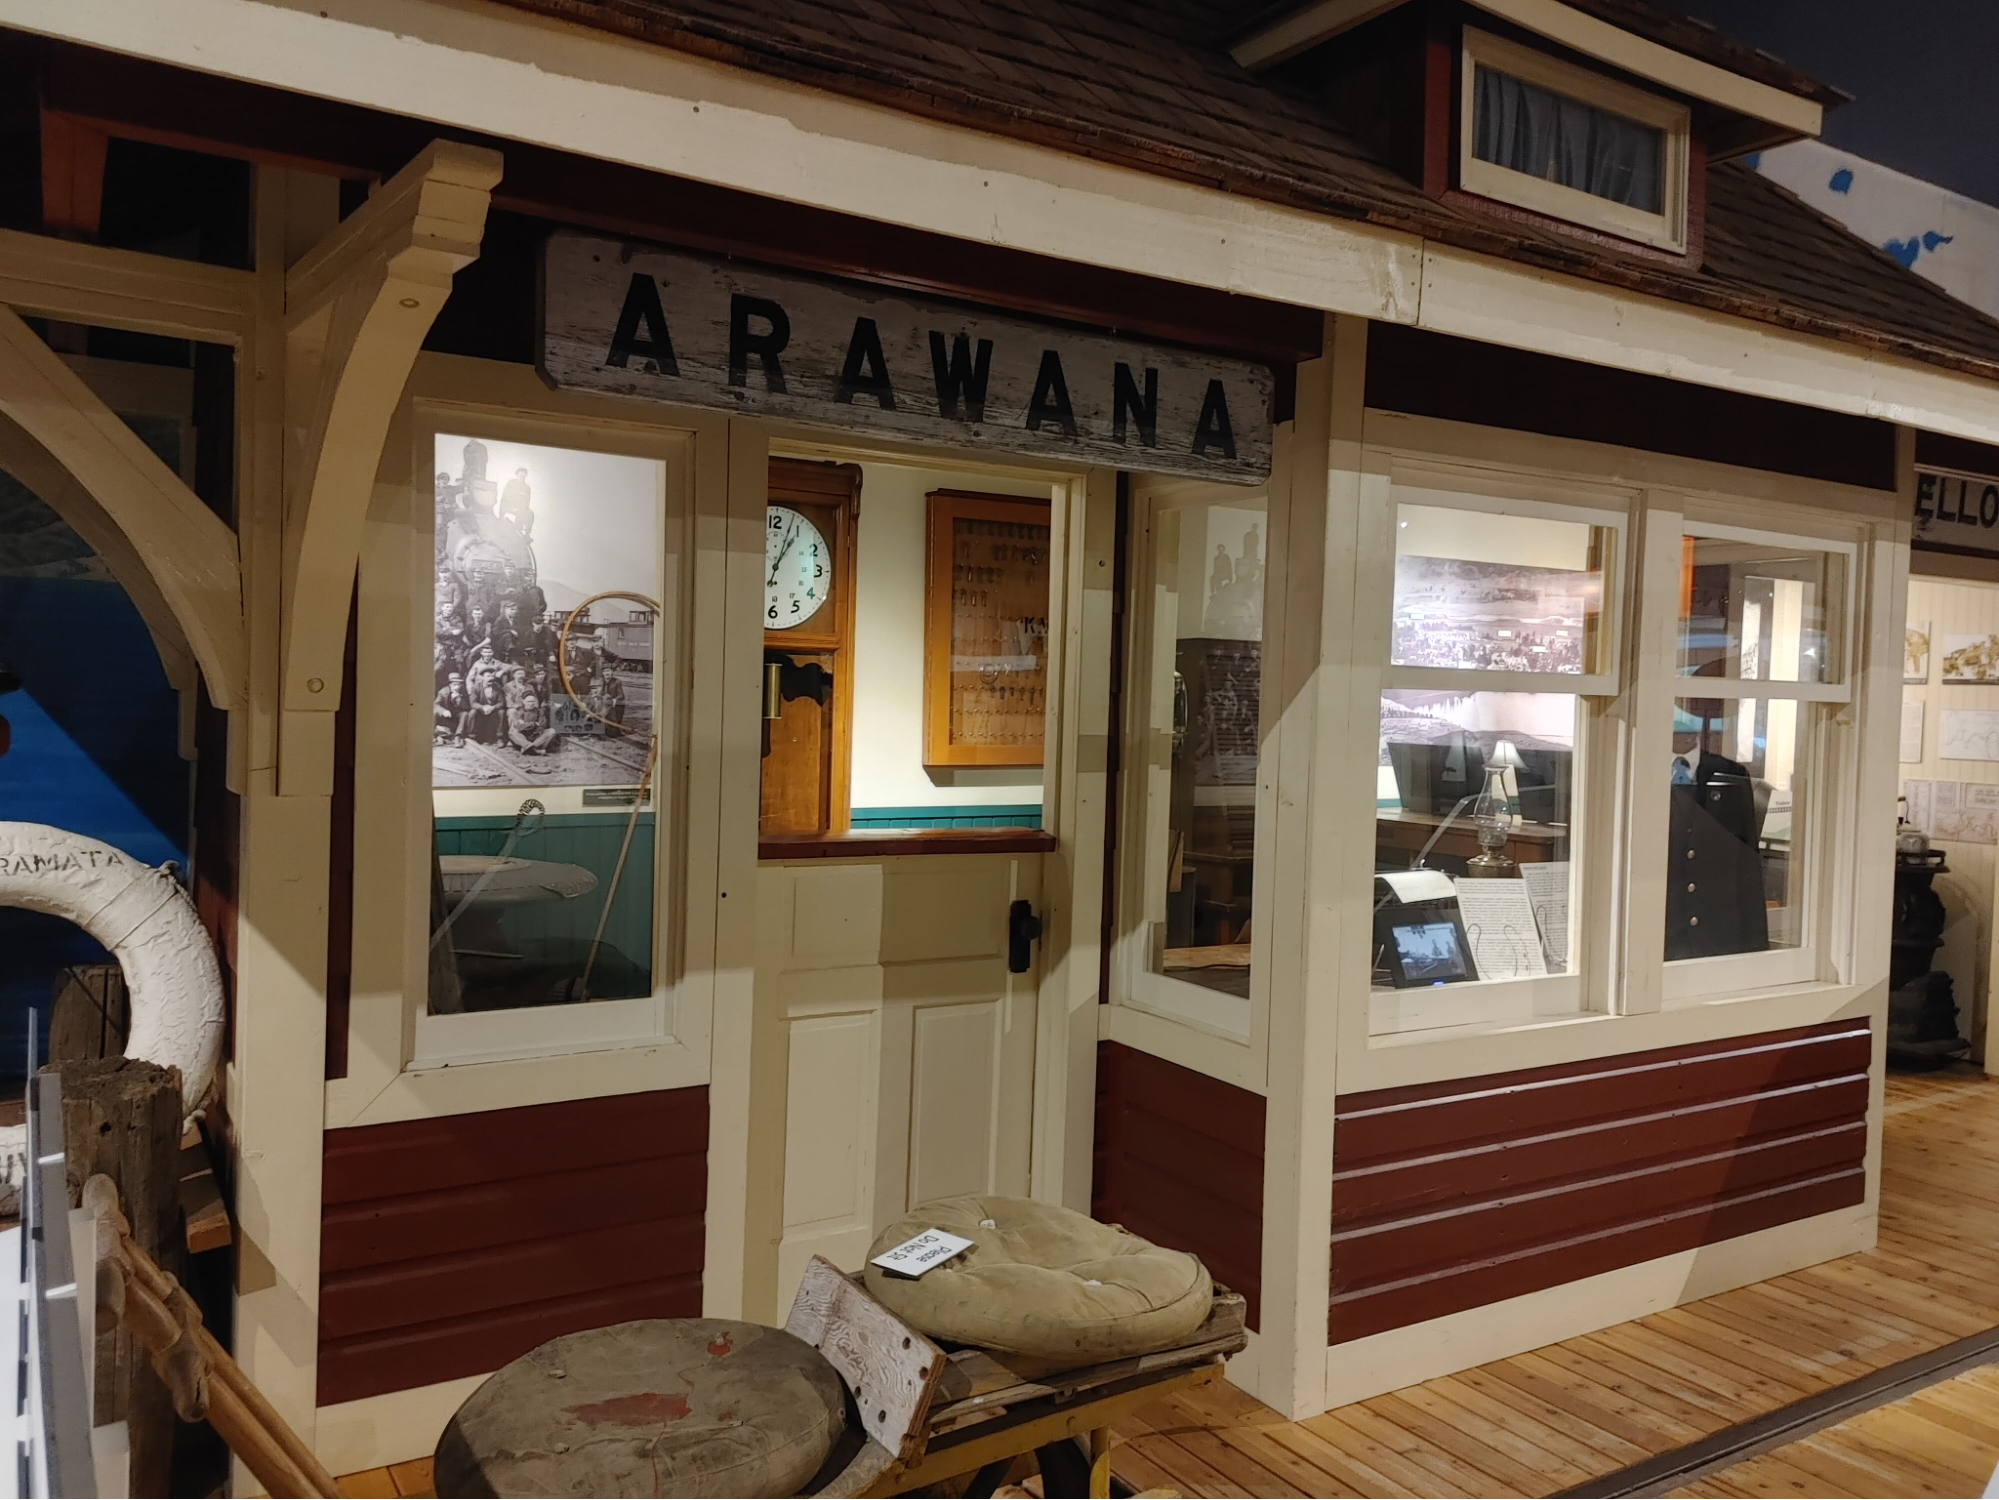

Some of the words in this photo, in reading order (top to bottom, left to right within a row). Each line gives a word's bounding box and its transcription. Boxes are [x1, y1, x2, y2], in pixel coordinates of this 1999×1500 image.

[605, 271, 1238, 460] ARAWANA
[1914, 473, 1999, 529] ELLO
[768, 515, 782, 530] 12
[796, 525, 800, 538] 1
[809, 544, 818, 557] 2
[814, 564, 822, 578] 3
[807, 587, 815, 599] 4
[768, 605, 778, 619] 6
[790, 600, 801, 613] 5
[918, 1235, 939, 1243] Do
[900, 1242, 926, 1253] Not
[916, 1246, 952, 1262] Please
[887, 1252, 907, 1260] Sit
